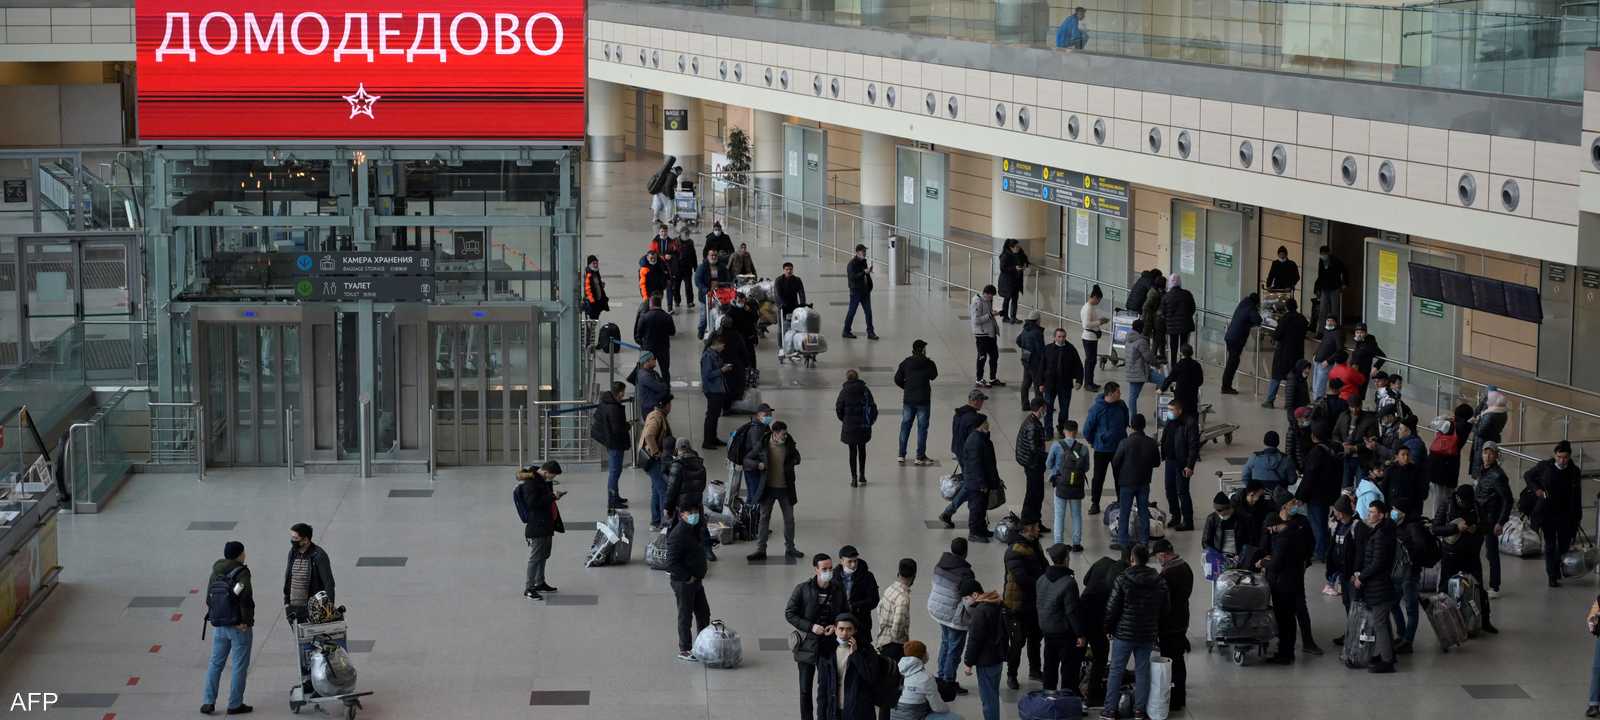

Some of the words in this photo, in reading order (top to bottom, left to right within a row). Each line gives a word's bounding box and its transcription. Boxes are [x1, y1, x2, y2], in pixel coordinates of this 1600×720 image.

[155, 12, 564, 63] ДОМОДЕДОВО
[342, 256, 373, 264] КАМЕРА
[374, 256, 413, 264] ХРАНЕНИЯ
